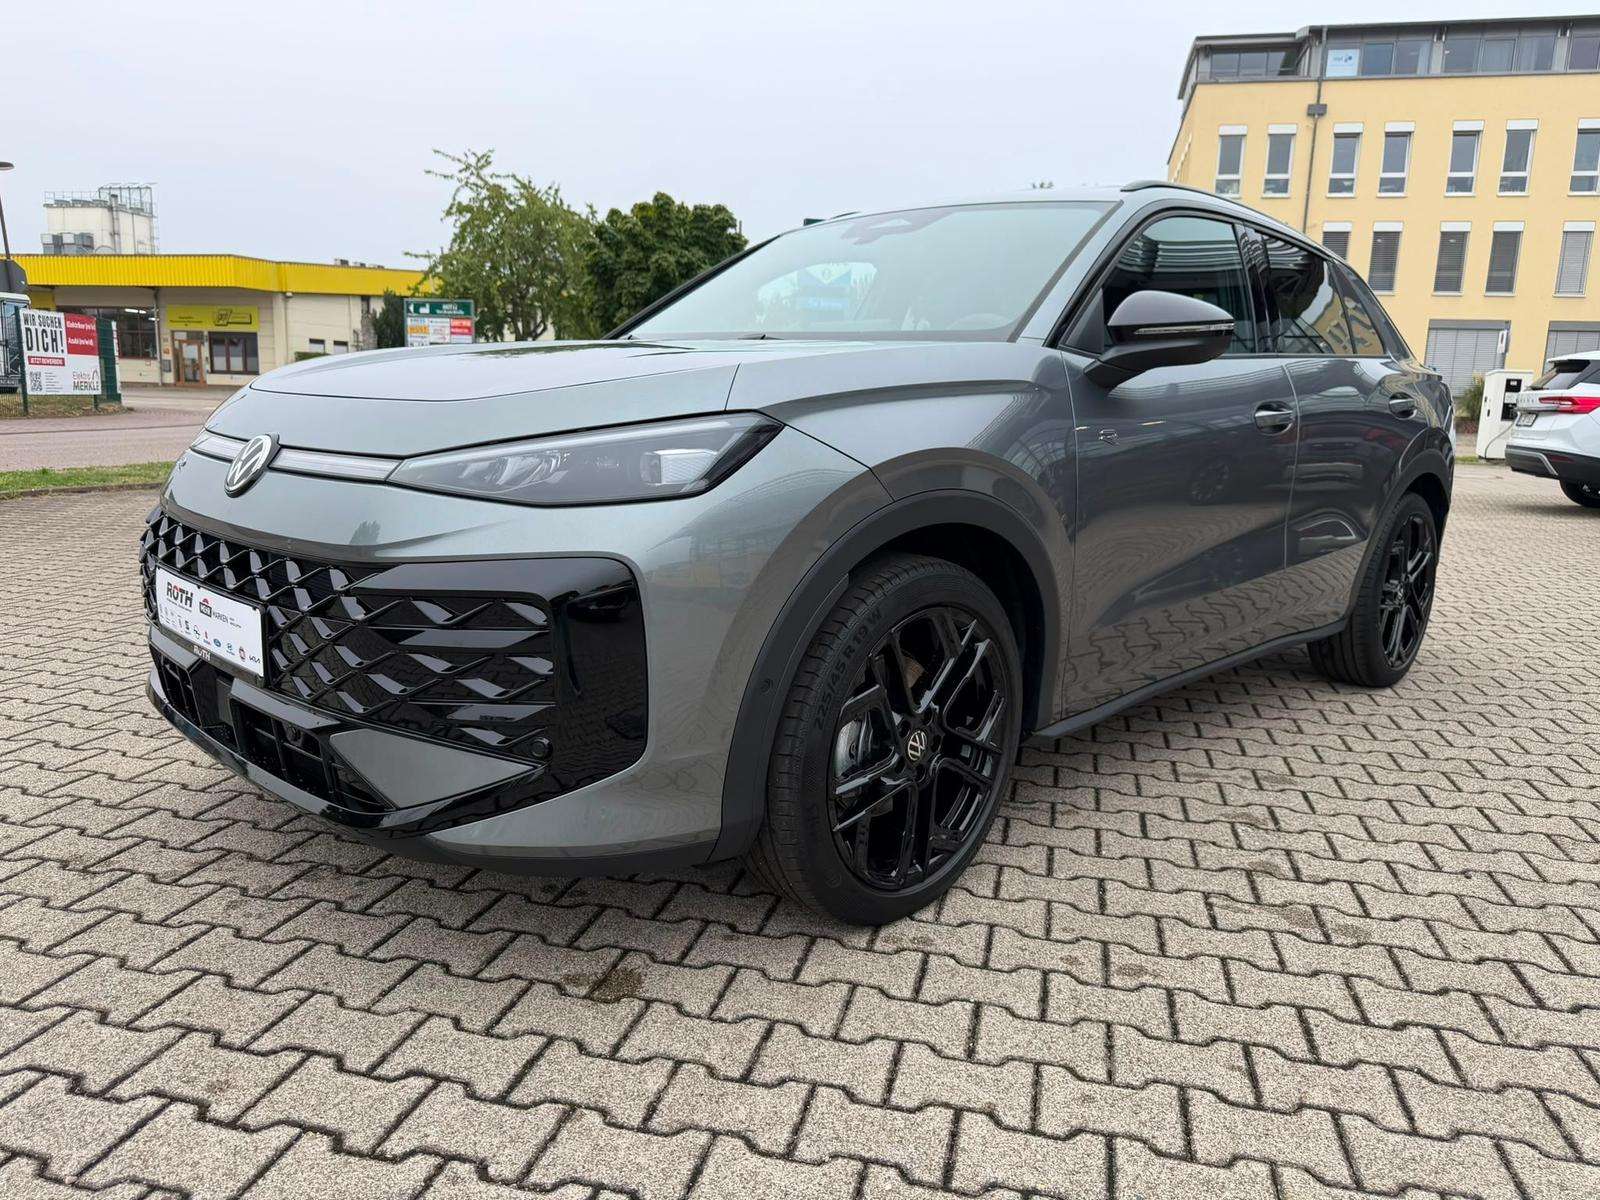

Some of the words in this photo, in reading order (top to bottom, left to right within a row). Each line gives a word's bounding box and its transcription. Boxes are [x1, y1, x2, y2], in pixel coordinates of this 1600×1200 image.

[23, 313, 36, 326] WIR
[38, 314, 62, 329] SUCHEN
[25, 327, 64, 353] DICH!
[73, 381, 99, 391] MERKLE
[166, 582, 193, 608] ROTH
